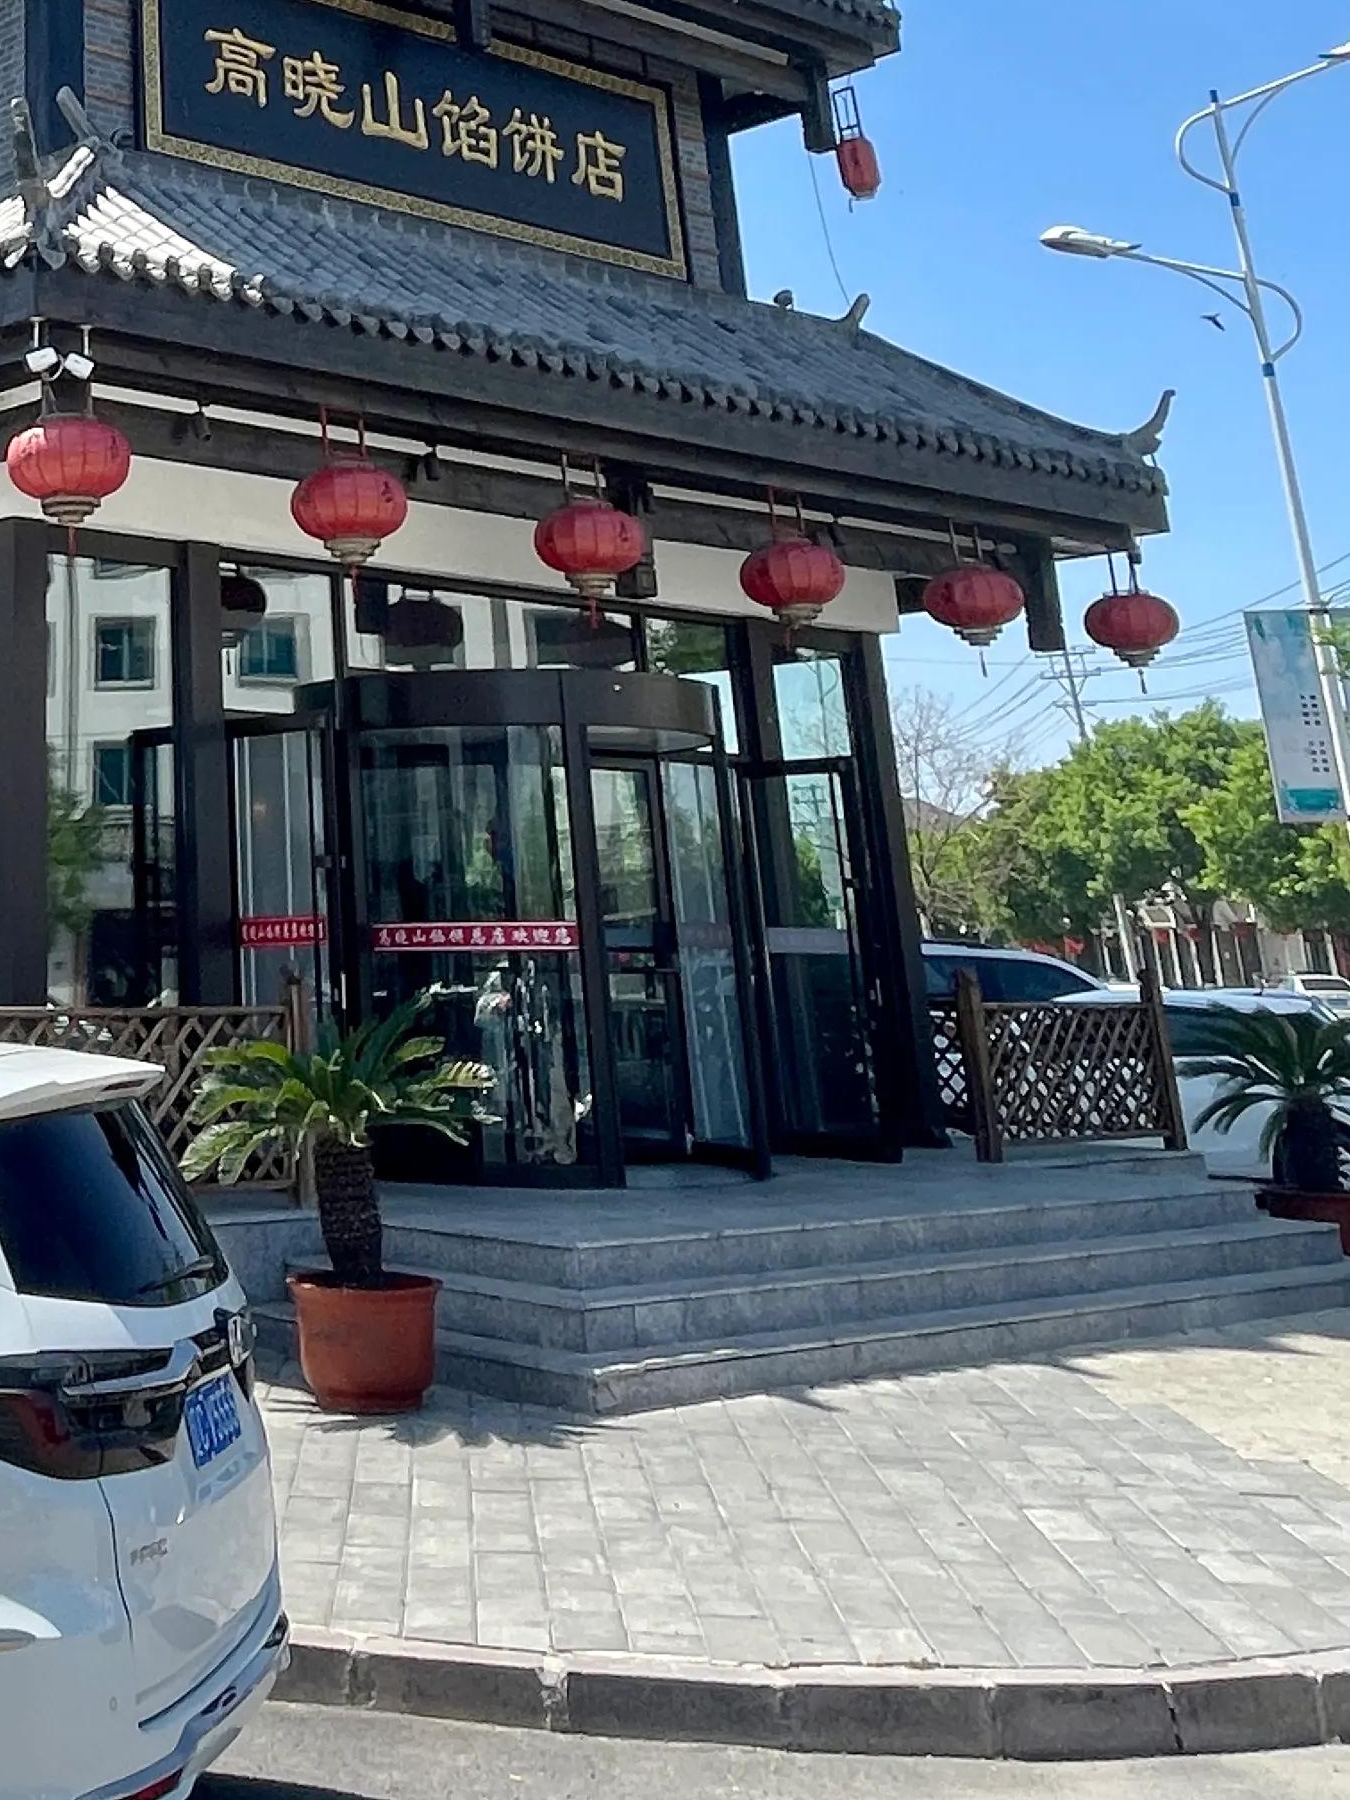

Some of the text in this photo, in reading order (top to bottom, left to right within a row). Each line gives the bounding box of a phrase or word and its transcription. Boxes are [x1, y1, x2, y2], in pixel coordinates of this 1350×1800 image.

[203, 26, 627, 203] 高晓山馅饼店
